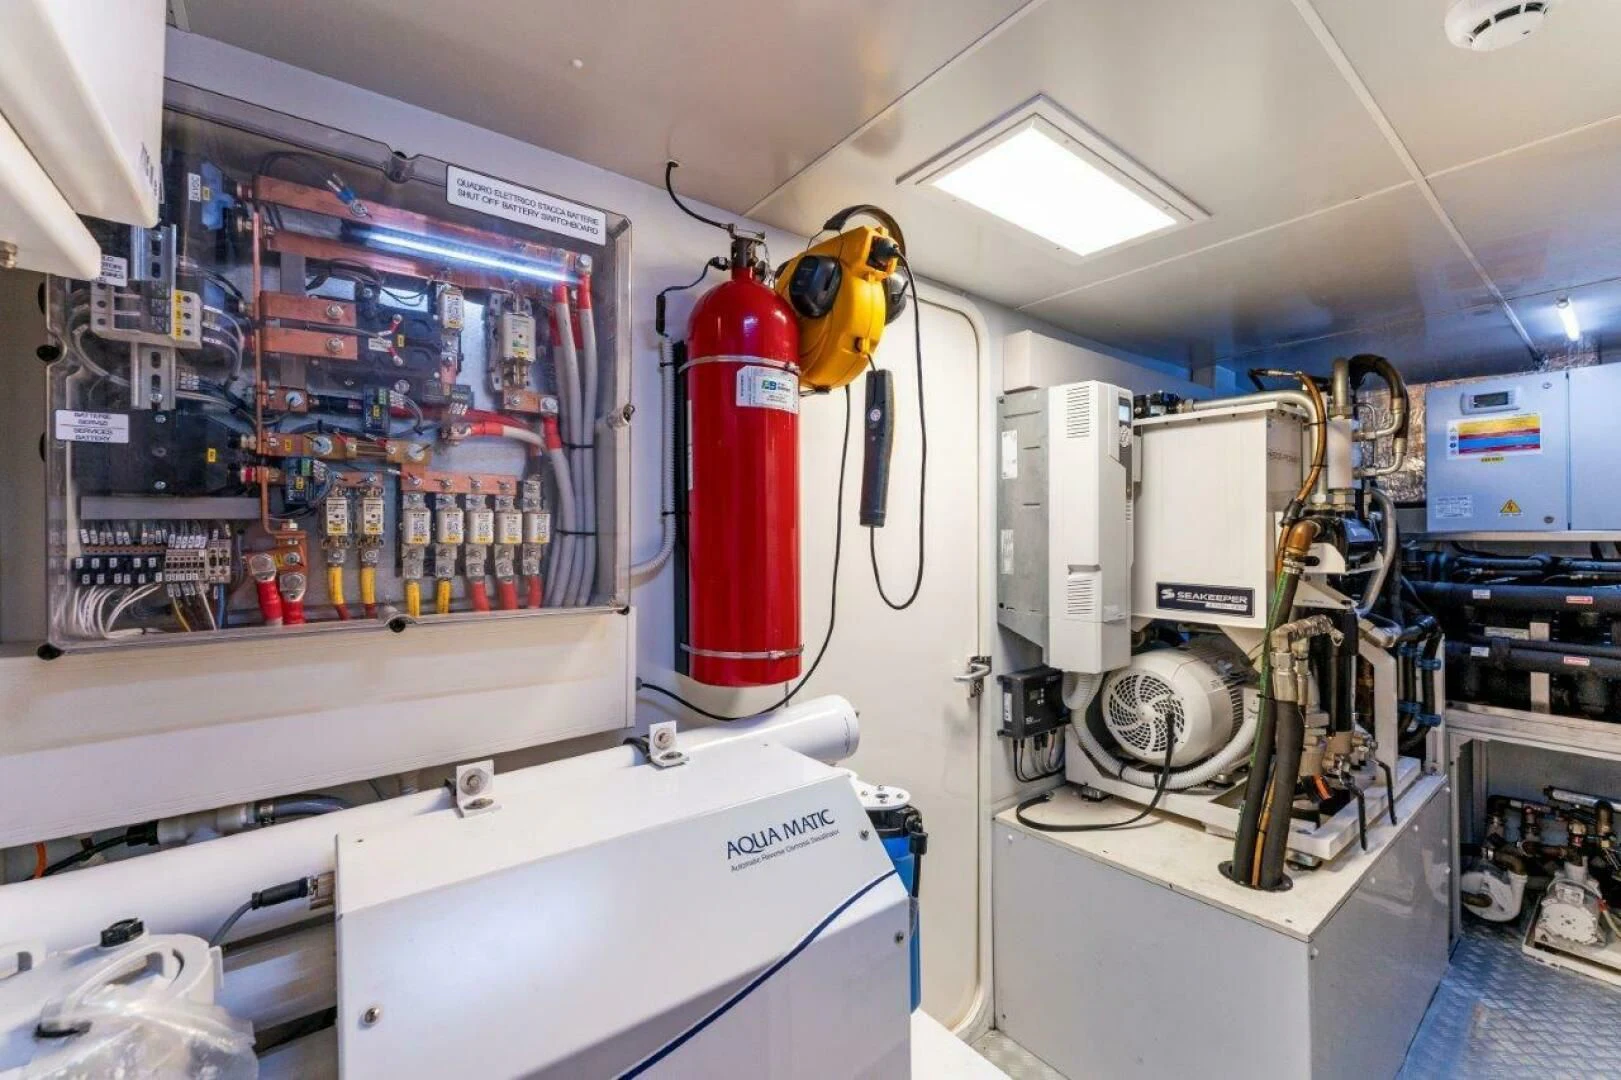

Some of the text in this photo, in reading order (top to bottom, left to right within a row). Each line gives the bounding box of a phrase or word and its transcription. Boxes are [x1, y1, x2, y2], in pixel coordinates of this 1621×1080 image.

[456, 178, 492, 196] QUADRO
[494, 187, 537, 207] ELETTRICO
[537, 200, 566, 216] STACCA
[457, 188, 600, 235] SHUT OFF BATTERY SWITCHBOARD
[1176, 590, 1248, 604] SEAKEEPER
[727, 808, 835, 860] AQUA MATIC
